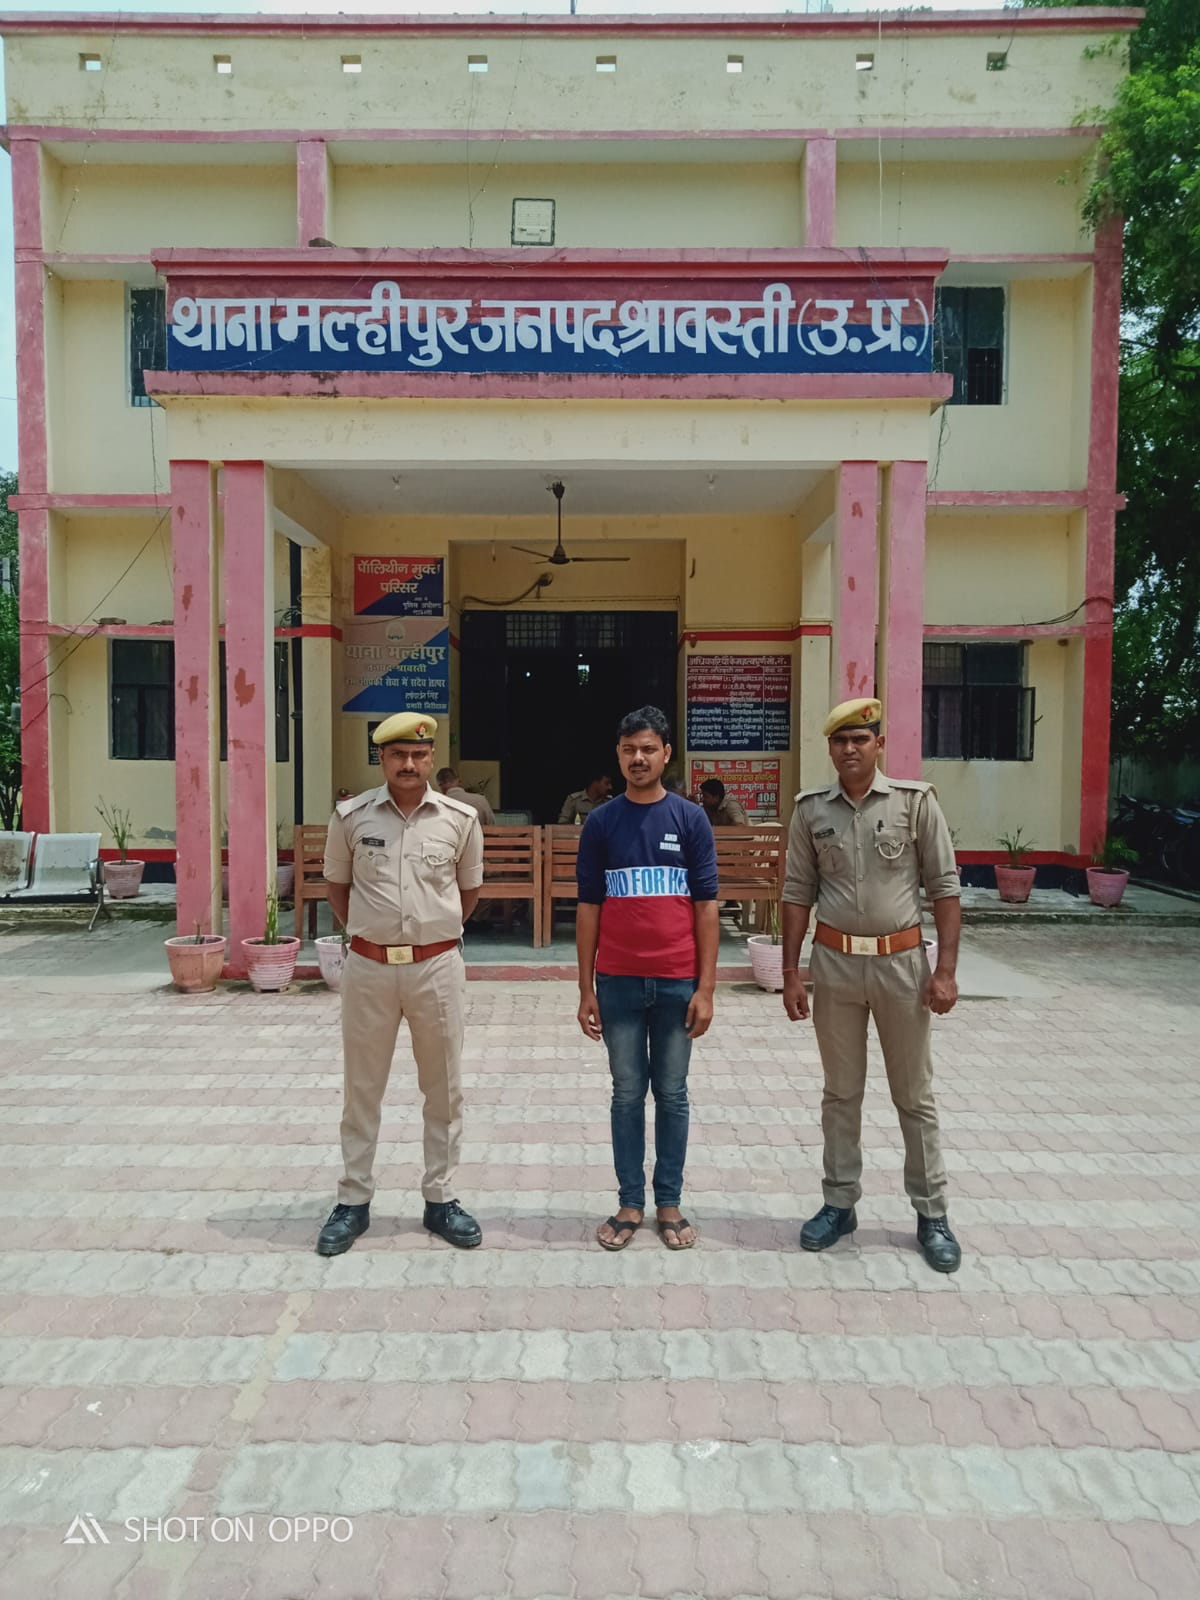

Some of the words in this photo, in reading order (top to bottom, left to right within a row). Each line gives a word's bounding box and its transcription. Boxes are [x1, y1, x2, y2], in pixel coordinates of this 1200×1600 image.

[171, 296, 273, 352] थाना
[275, 281, 472, 367] मल्हीपुर
[470, 298, 621, 357] जनपद
[617, 282, 796, 359] श्रावस्ती
[411, 563, 441, 580] मुक्त
[379, 578, 419, 594] परिसर
[387, 642, 446, 665] मल्हीपुर
[757, 792, 777, 802] 108
[631, 867, 666, 896] FOR
